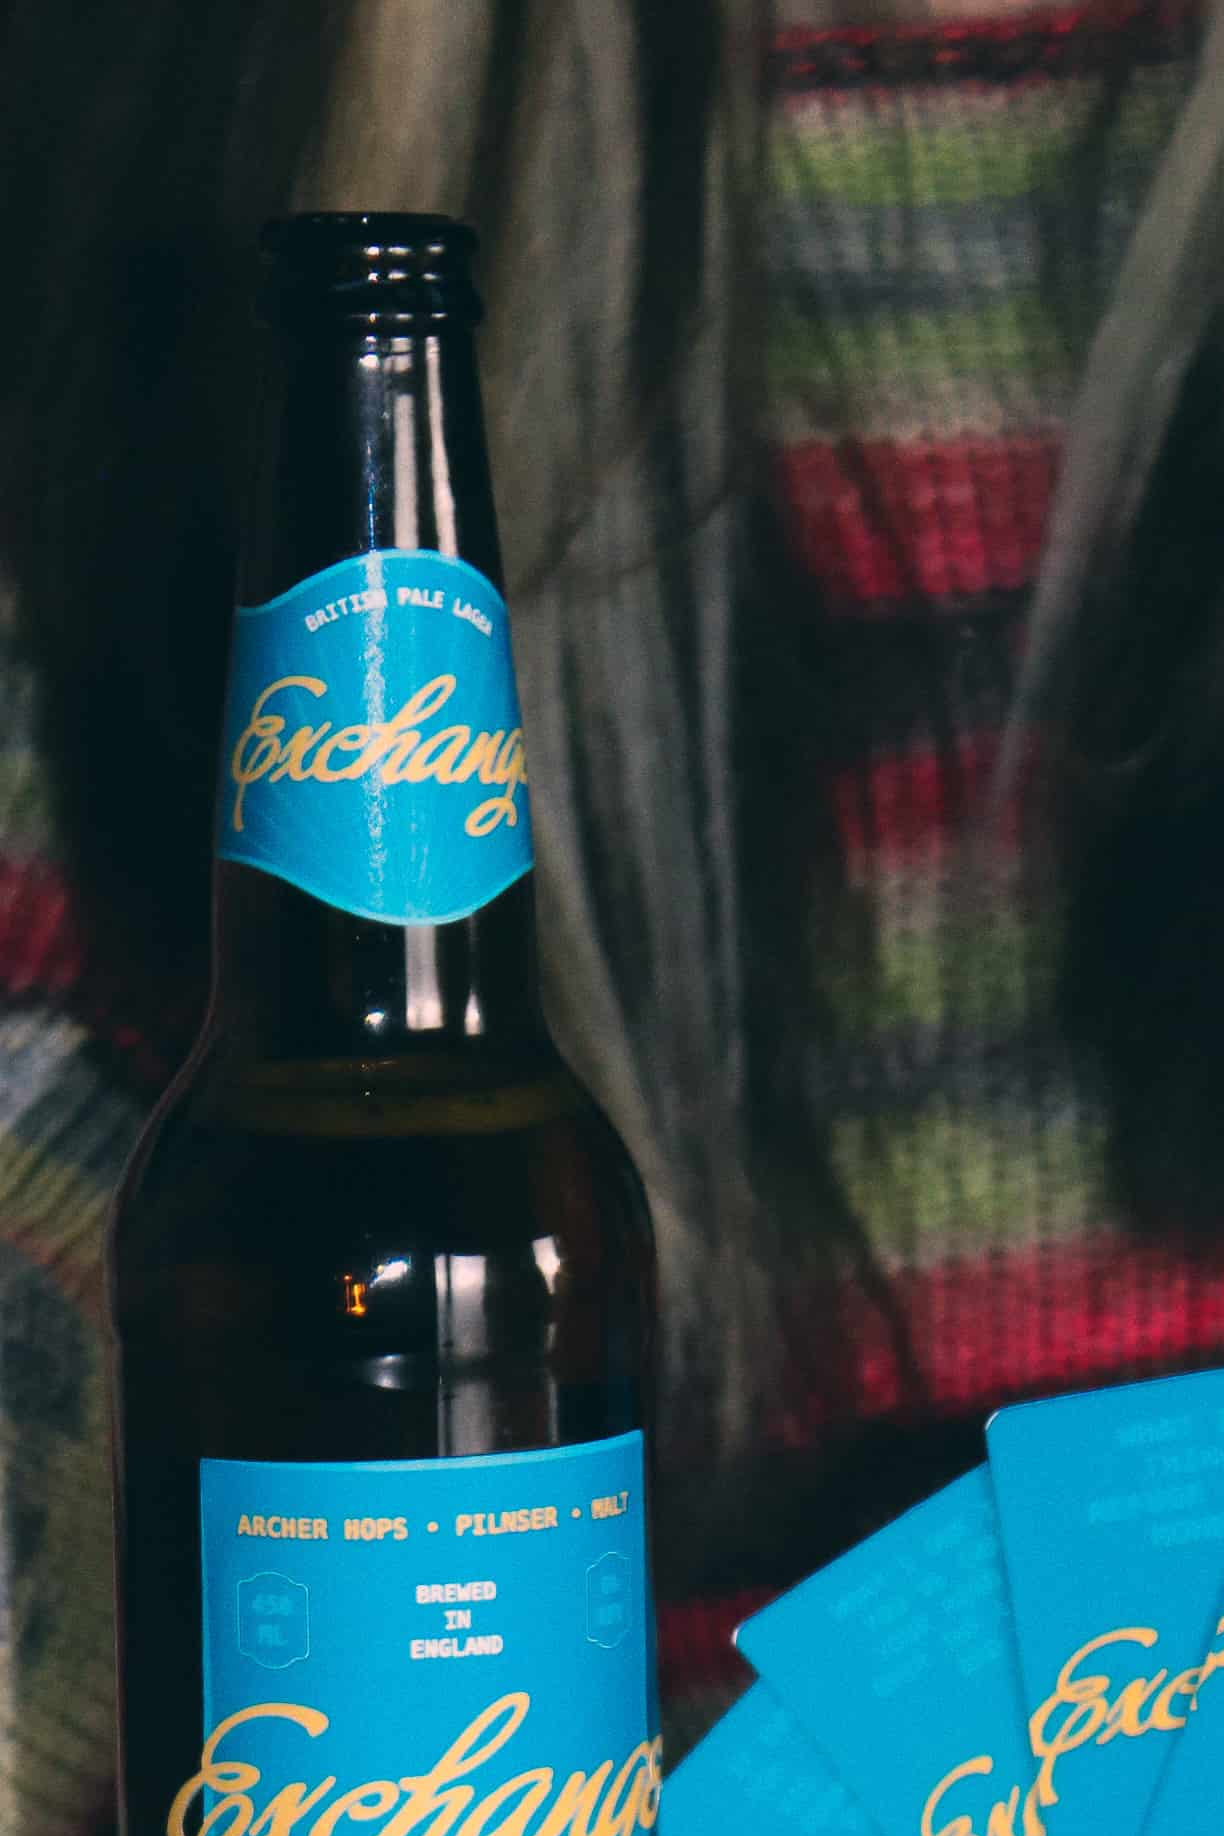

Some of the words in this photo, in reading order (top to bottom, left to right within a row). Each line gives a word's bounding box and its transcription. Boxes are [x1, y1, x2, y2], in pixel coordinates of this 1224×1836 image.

[397, 587, 445, 609] PALE
[237, 1514, 329, 1540] ARCHER
[343, 1516, 408, 1541] HOPS
[416, 1581, 497, 1604] BREWED
[444, 1610, 472, 1630] IN
[410, 1635, 503, 1660] ENGLAND
